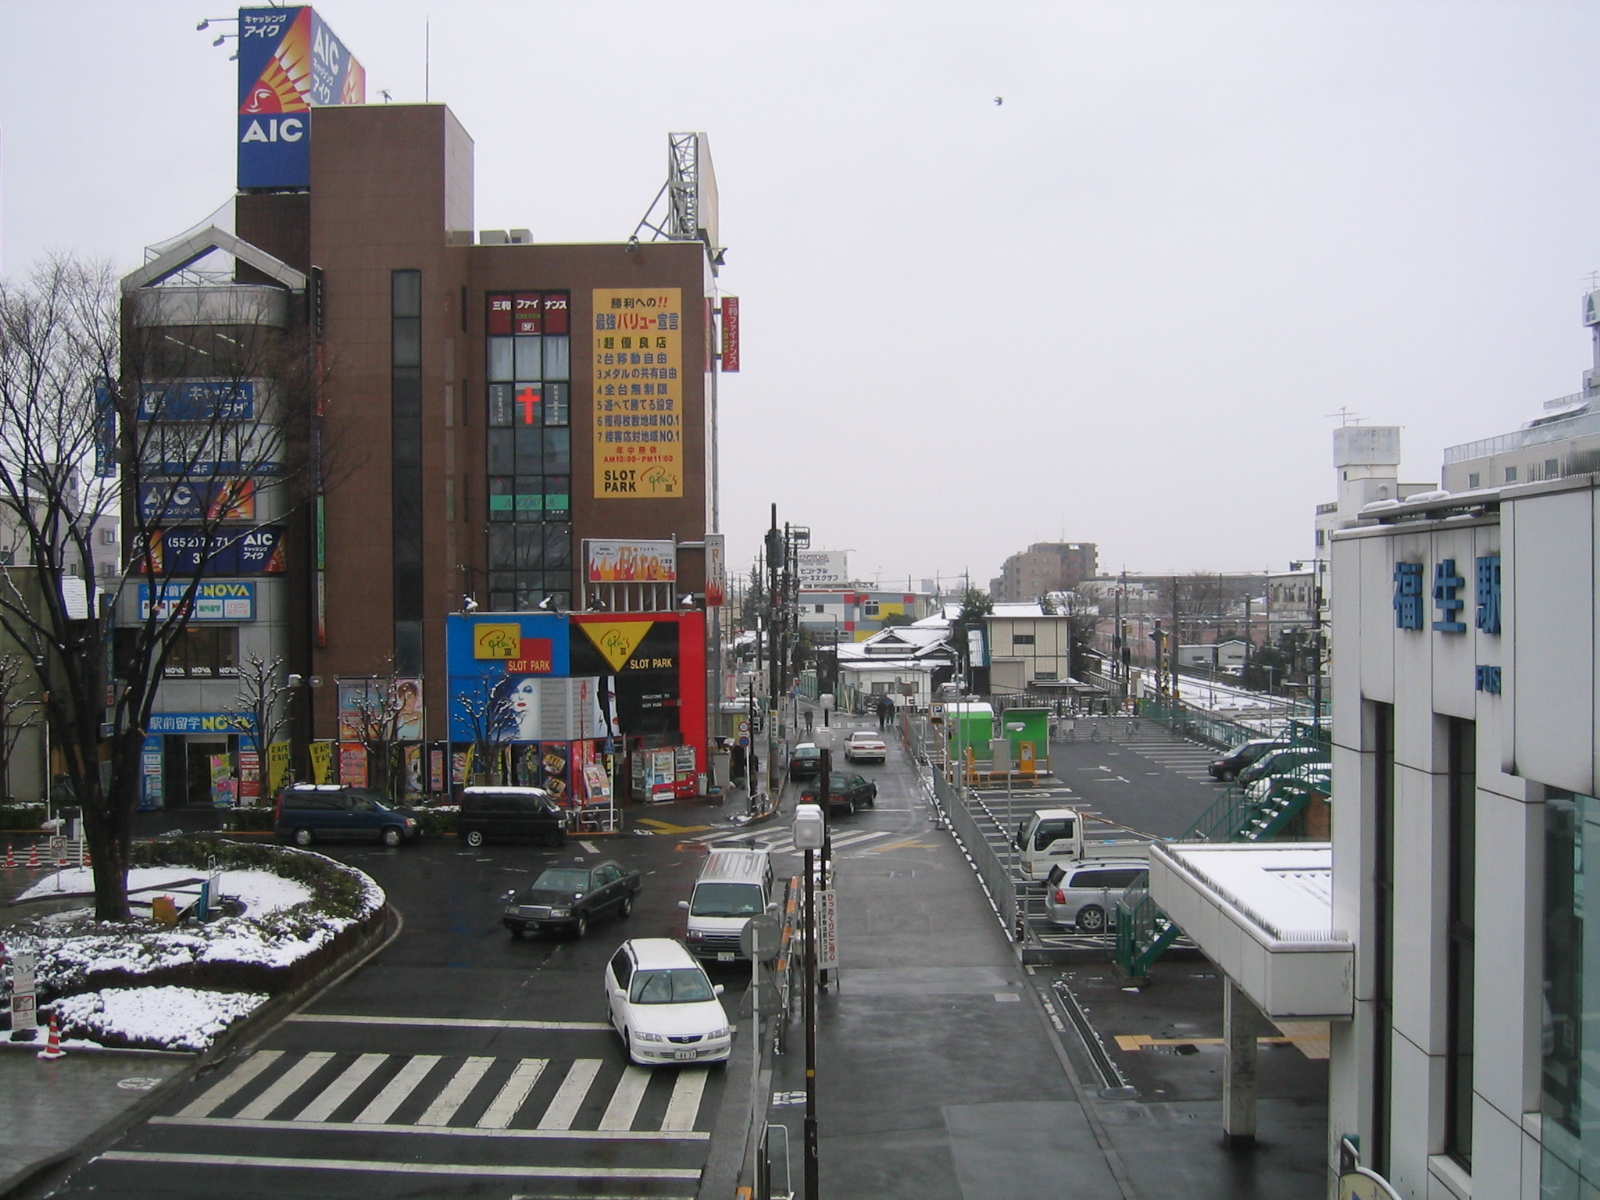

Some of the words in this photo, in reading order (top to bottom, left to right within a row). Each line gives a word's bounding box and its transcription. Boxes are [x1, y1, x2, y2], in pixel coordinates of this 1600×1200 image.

[244, 14, 287, 24] キャッシング
[244, 25, 280, 38] アイク
[313, 26, 340, 75] AIC
[241, 118, 304, 143] AIC
[595, 312, 679, 330] 最強バリュー宣言
[604, 470, 636, 481] SLOT
[604, 482, 637, 492] PARK
[168, 537, 229, 548] (552)771
[243, 533, 273, 546] AIC
[243, 552, 265, 560] アイク
[203, 584, 250, 598] NOVA
[1392, 556, 1501, 634] 福生駅
[508, 661, 527, 671] SLOT
[530, 661, 550, 671] PARK
[630, 659, 650, 670] SLOT
[652, 658, 673, 668] PARK
[150, 716, 200, 730] 駅前留学
